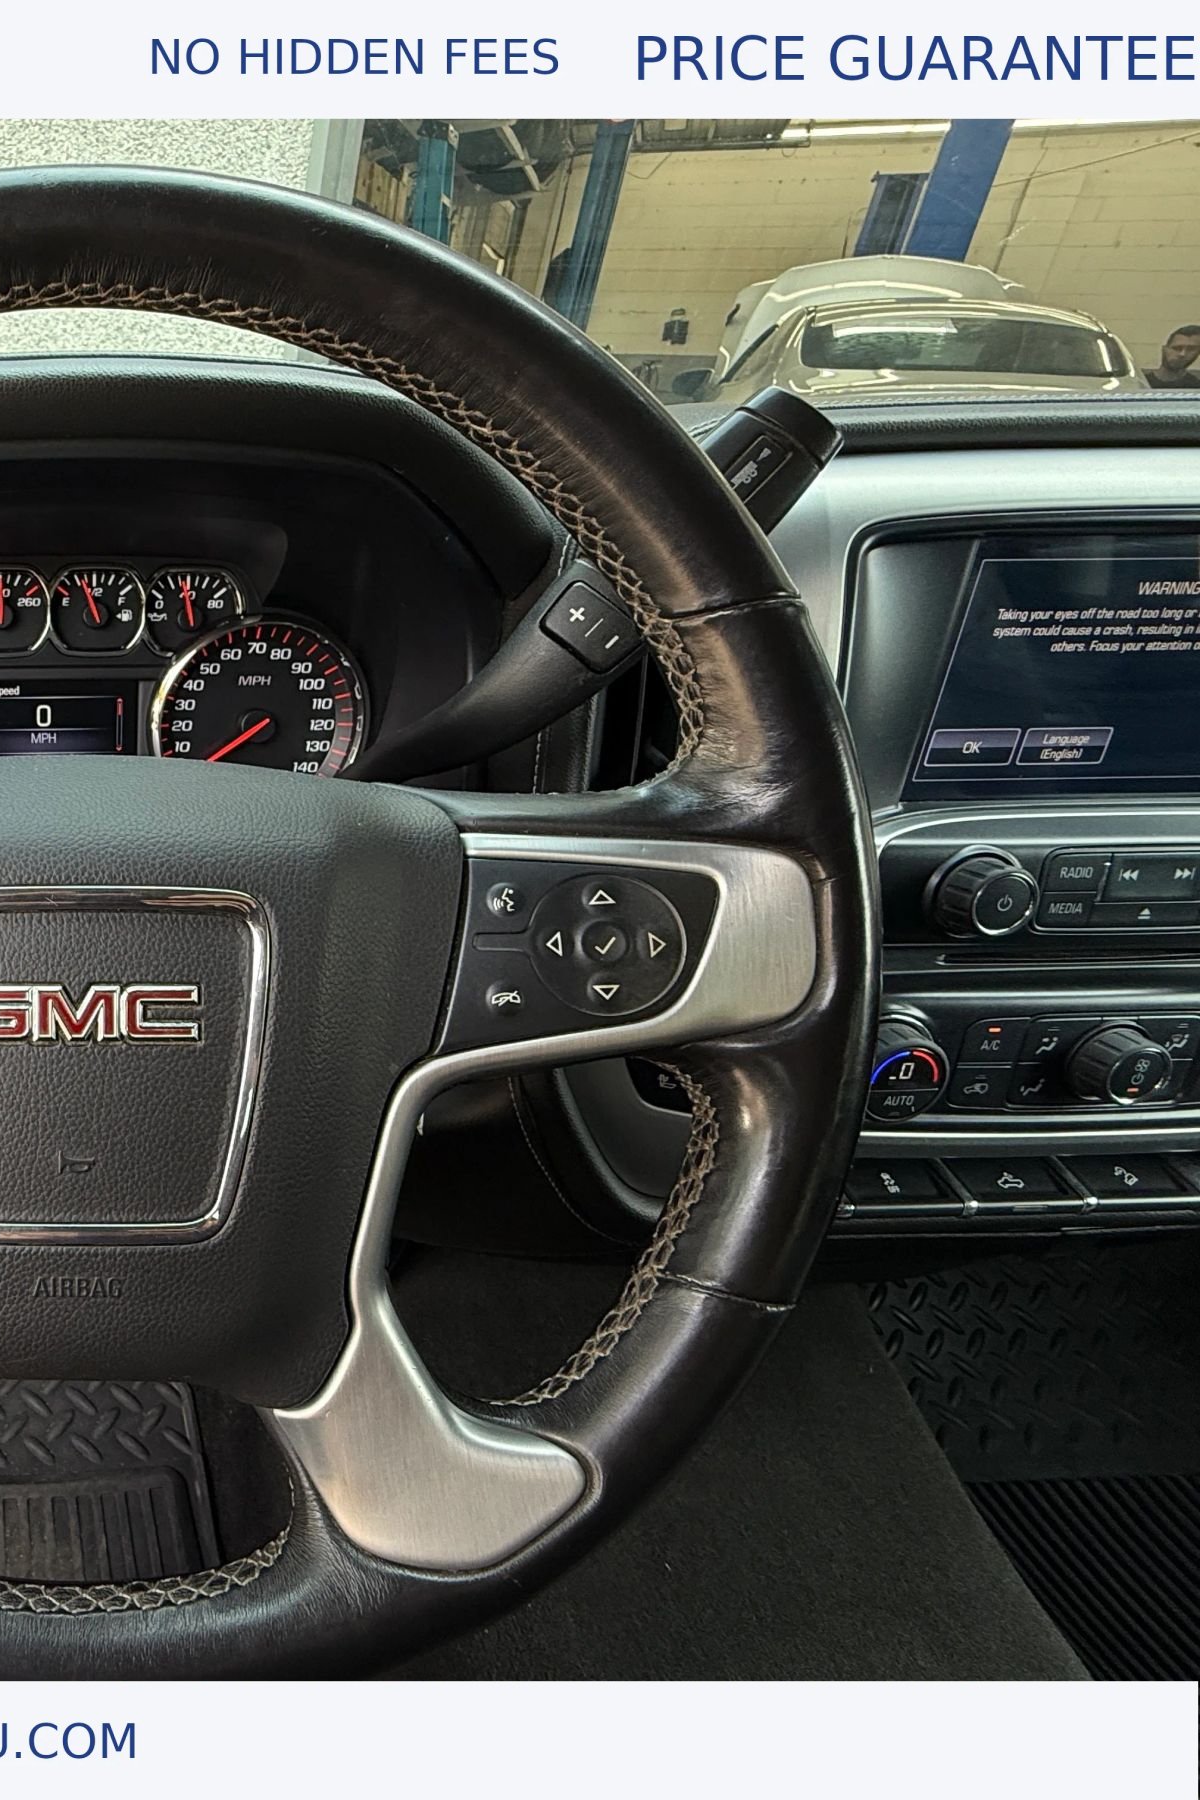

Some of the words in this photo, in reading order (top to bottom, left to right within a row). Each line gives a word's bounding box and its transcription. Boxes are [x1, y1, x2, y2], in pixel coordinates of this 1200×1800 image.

[17, 597, 41, 608] 260
[62, 597, 70, 607] E
[118, 597, 126, 606] F
[155, 600, 164, 610] 0
[207, 599, 224, 609] 80
[998, 609, 1028, 622] Taking
[1029, 610, 1053, 623] your
[1054, 610, 1078, 622] eyes
[1080, 608, 1099, 619] off
[1098, 608, 1114, 619] the
[1115, 607, 1141, 619] road
[1141, 608, 1159, 618] too
[1161, 607, 1183, 621] long
[1184, 608, 1198, 618] or
[993, 626, 1031, 638] system
[1032, 625, 1061, 636] could
[1061, 626, 1092, 636] cause
[1093, 627, 1101, 636] a
[1102, 625, 1134, 637] crash,
[1136, 624, 1183, 637] resulting
[248, 642, 267, 654] 70
[1050, 640, 1086, 652] others.
[1089, 640, 1120, 652] Focus
[1119, 641, 1145, 654] your
[1145, 640, 1192, 651] attention
[220, 649, 242, 660] 60
[270, 648, 292, 660] 80
[200, 663, 221, 675] 50
[291, 662, 312, 674] 90
[183, 679, 205, 691] 40
[238, 676, 272, 686] MPH
[299, 678, 325, 690] 100
[175, 699, 196, 711] 30
[312, 698, 333, 710] 110
[36, 704, 52, 727] 0
[172, 720, 193, 732] 20
[310, 720, 334, 731] 120
[30, 733, 57, 744] MPH
[1042, 734, 1090, 746] Language
[175, 741, 191, 752] 10
[306, 740, 331, 752] 130
[962, 741, 983, 754] OK
[1040, 748, 1083, 761] (English)
[293, 761, 318, 773] 140
[1060, 867, 1093, 879] RADIO
[1048, 902, 1083, 915] MEDIA
[980, 1039, 1001, 1052] A/C
[883, 1096, 915, 1106] AUTO
[33, 1276, 122, 1299] AIRBAG
